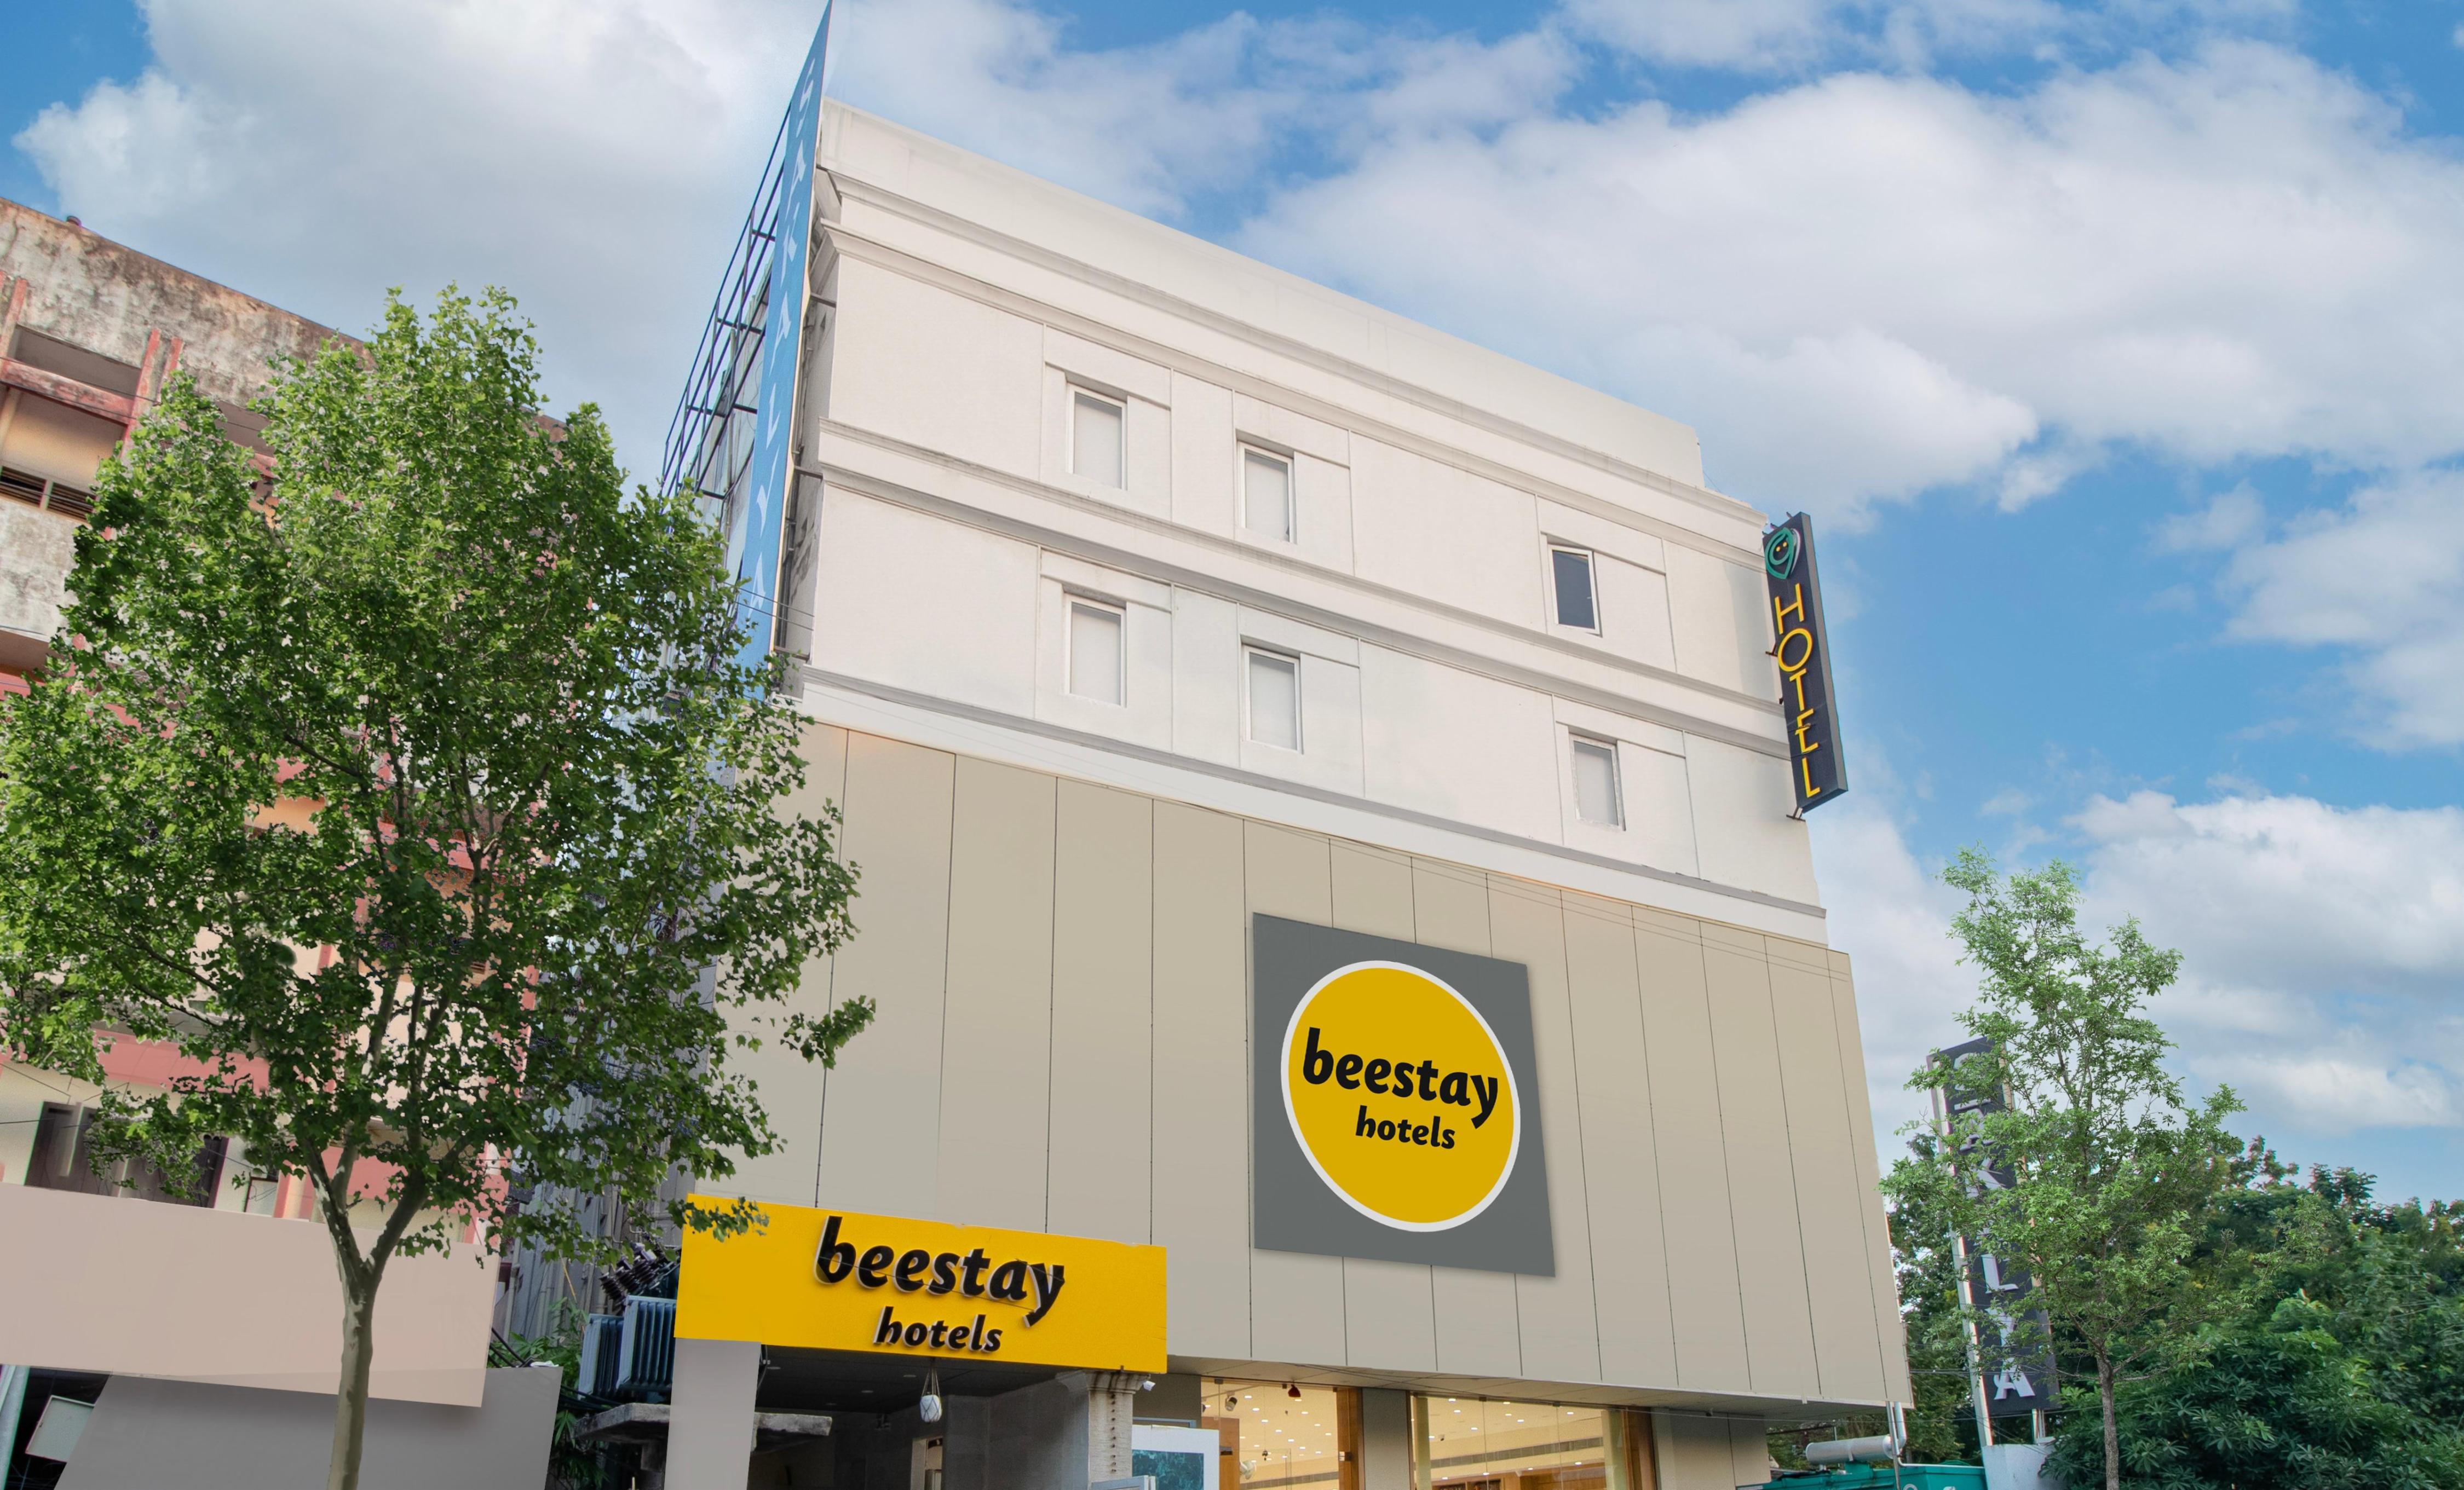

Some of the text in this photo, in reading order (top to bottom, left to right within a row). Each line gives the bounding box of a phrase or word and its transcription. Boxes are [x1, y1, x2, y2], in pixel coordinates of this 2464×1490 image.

[1774, 583, 1820, 799] HOTEL
[1303, 1026, 1498, 1129] beestay
[1355, 1105, 1455, 1149] hotels
[814, 1216, 1064, 1327] beestay
[873, 1306, 1003, 1353] hotels
